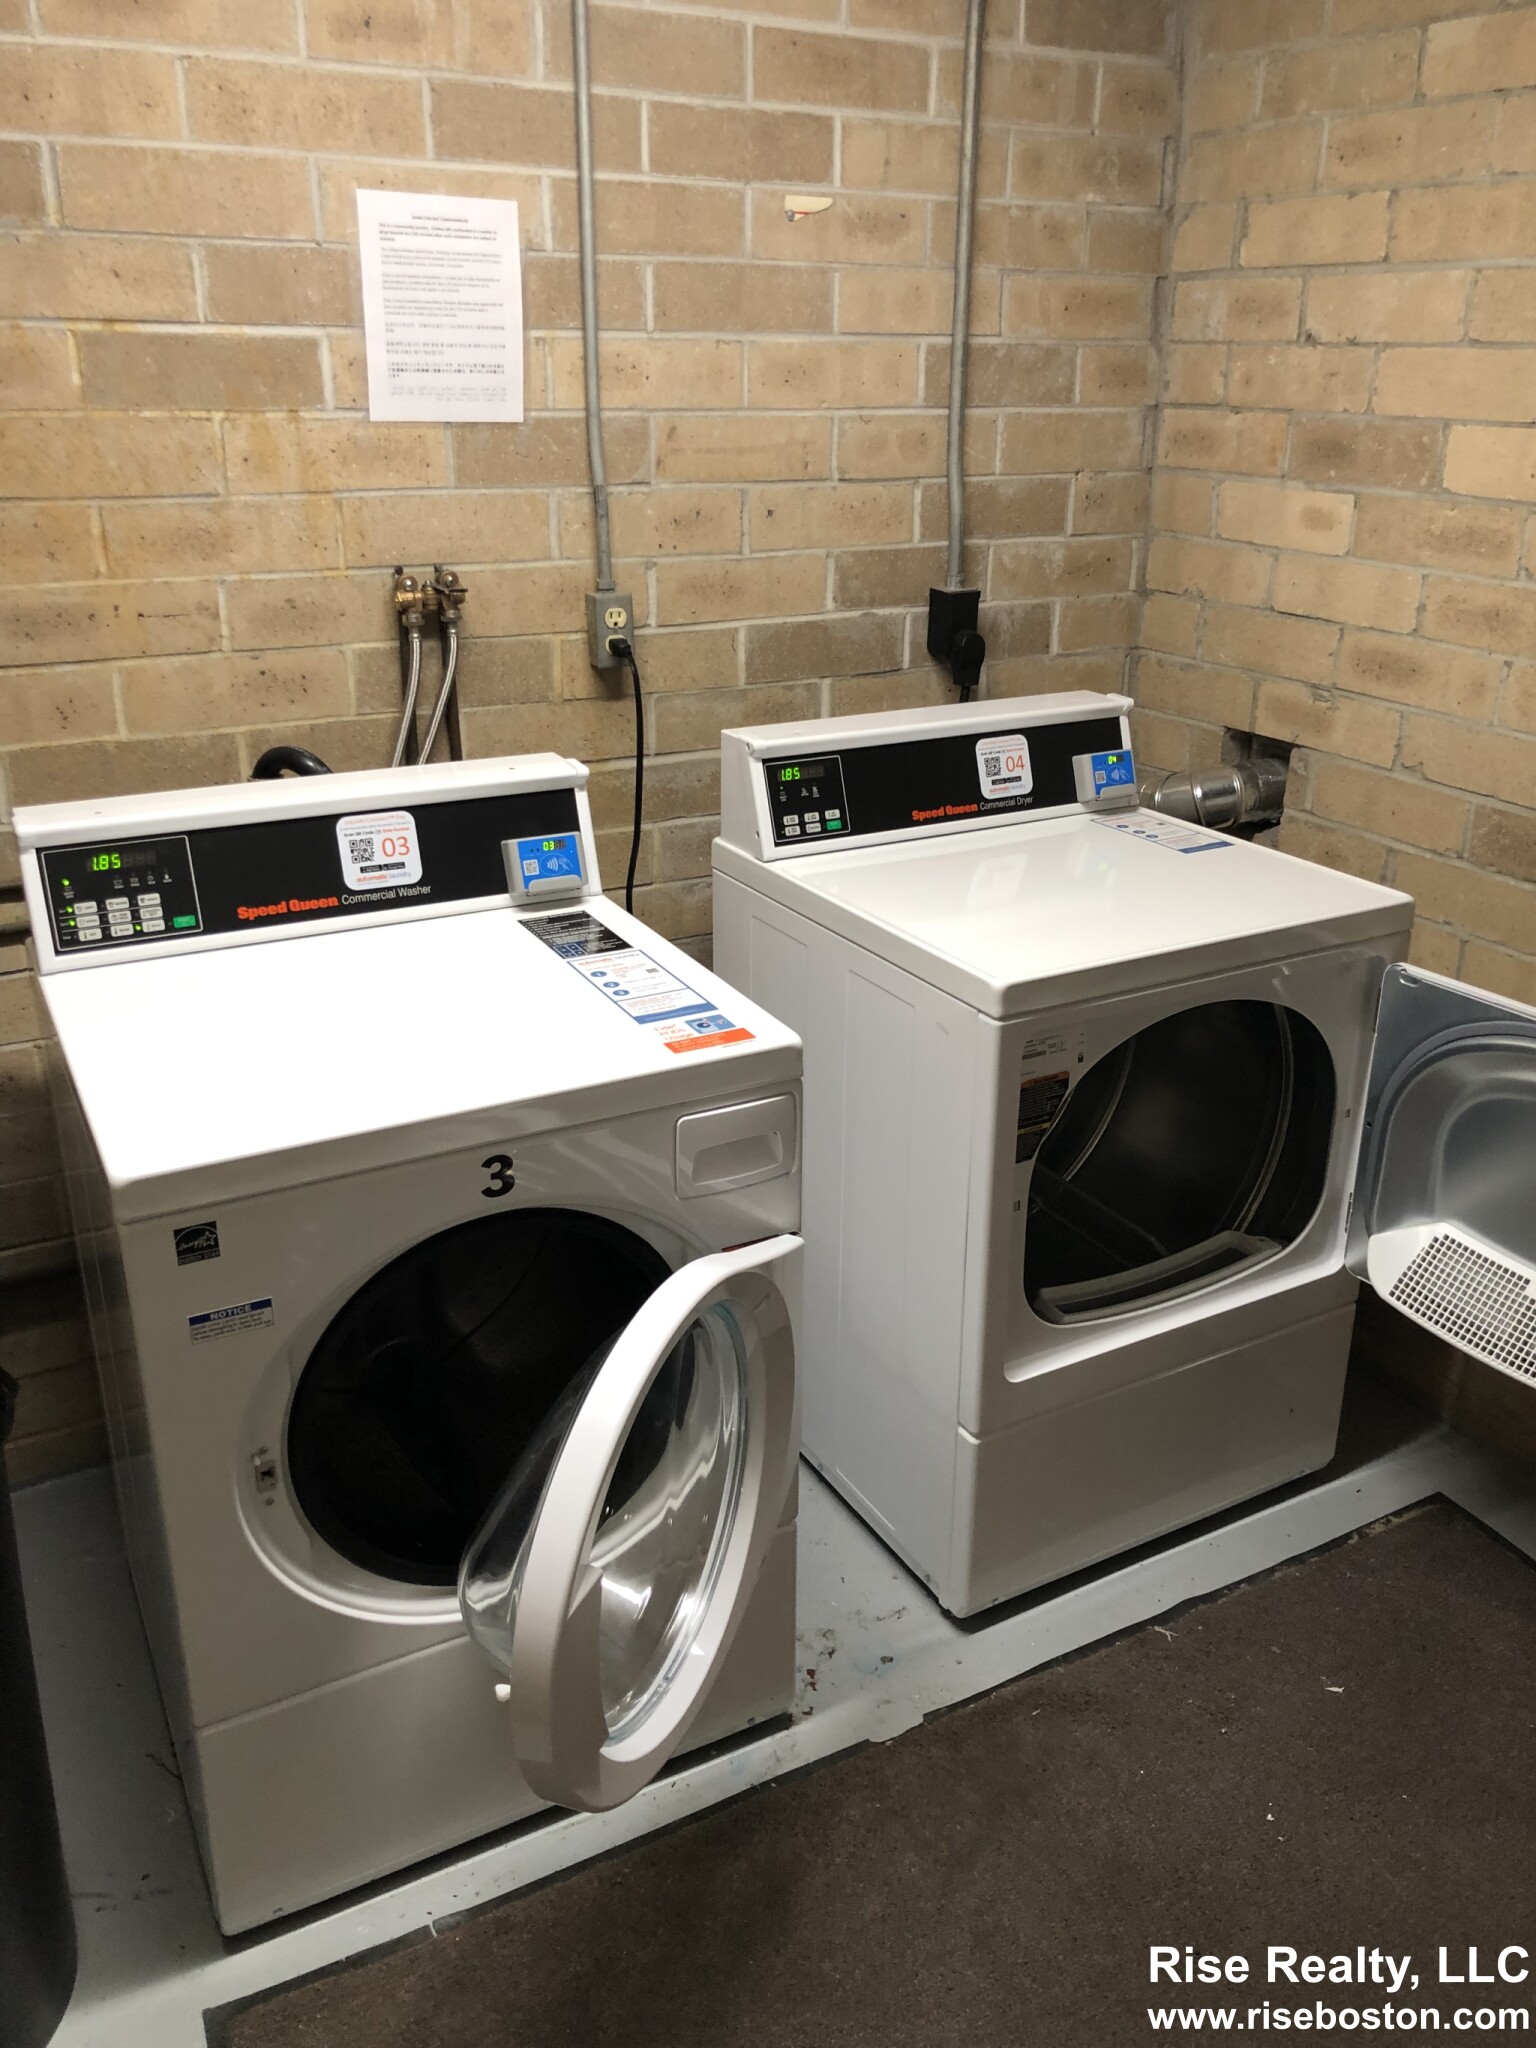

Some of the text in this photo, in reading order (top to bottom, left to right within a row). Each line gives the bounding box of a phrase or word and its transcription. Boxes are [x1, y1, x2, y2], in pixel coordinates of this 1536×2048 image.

[1006, 754, 1025, 772] 04
[1108, 755, 1117, 765] 04
[912, 796, 1033, 821] Speed Queen Commercial Dryer
[382, 836, 410, 857] 03
[542, 840, 555, 852] 03
[236, 885, 432, 920] Speed Queen Commercial Washer
[480, 1154, 516, 1198] 3
[210, 1304, 252, 1320] NOTICE
